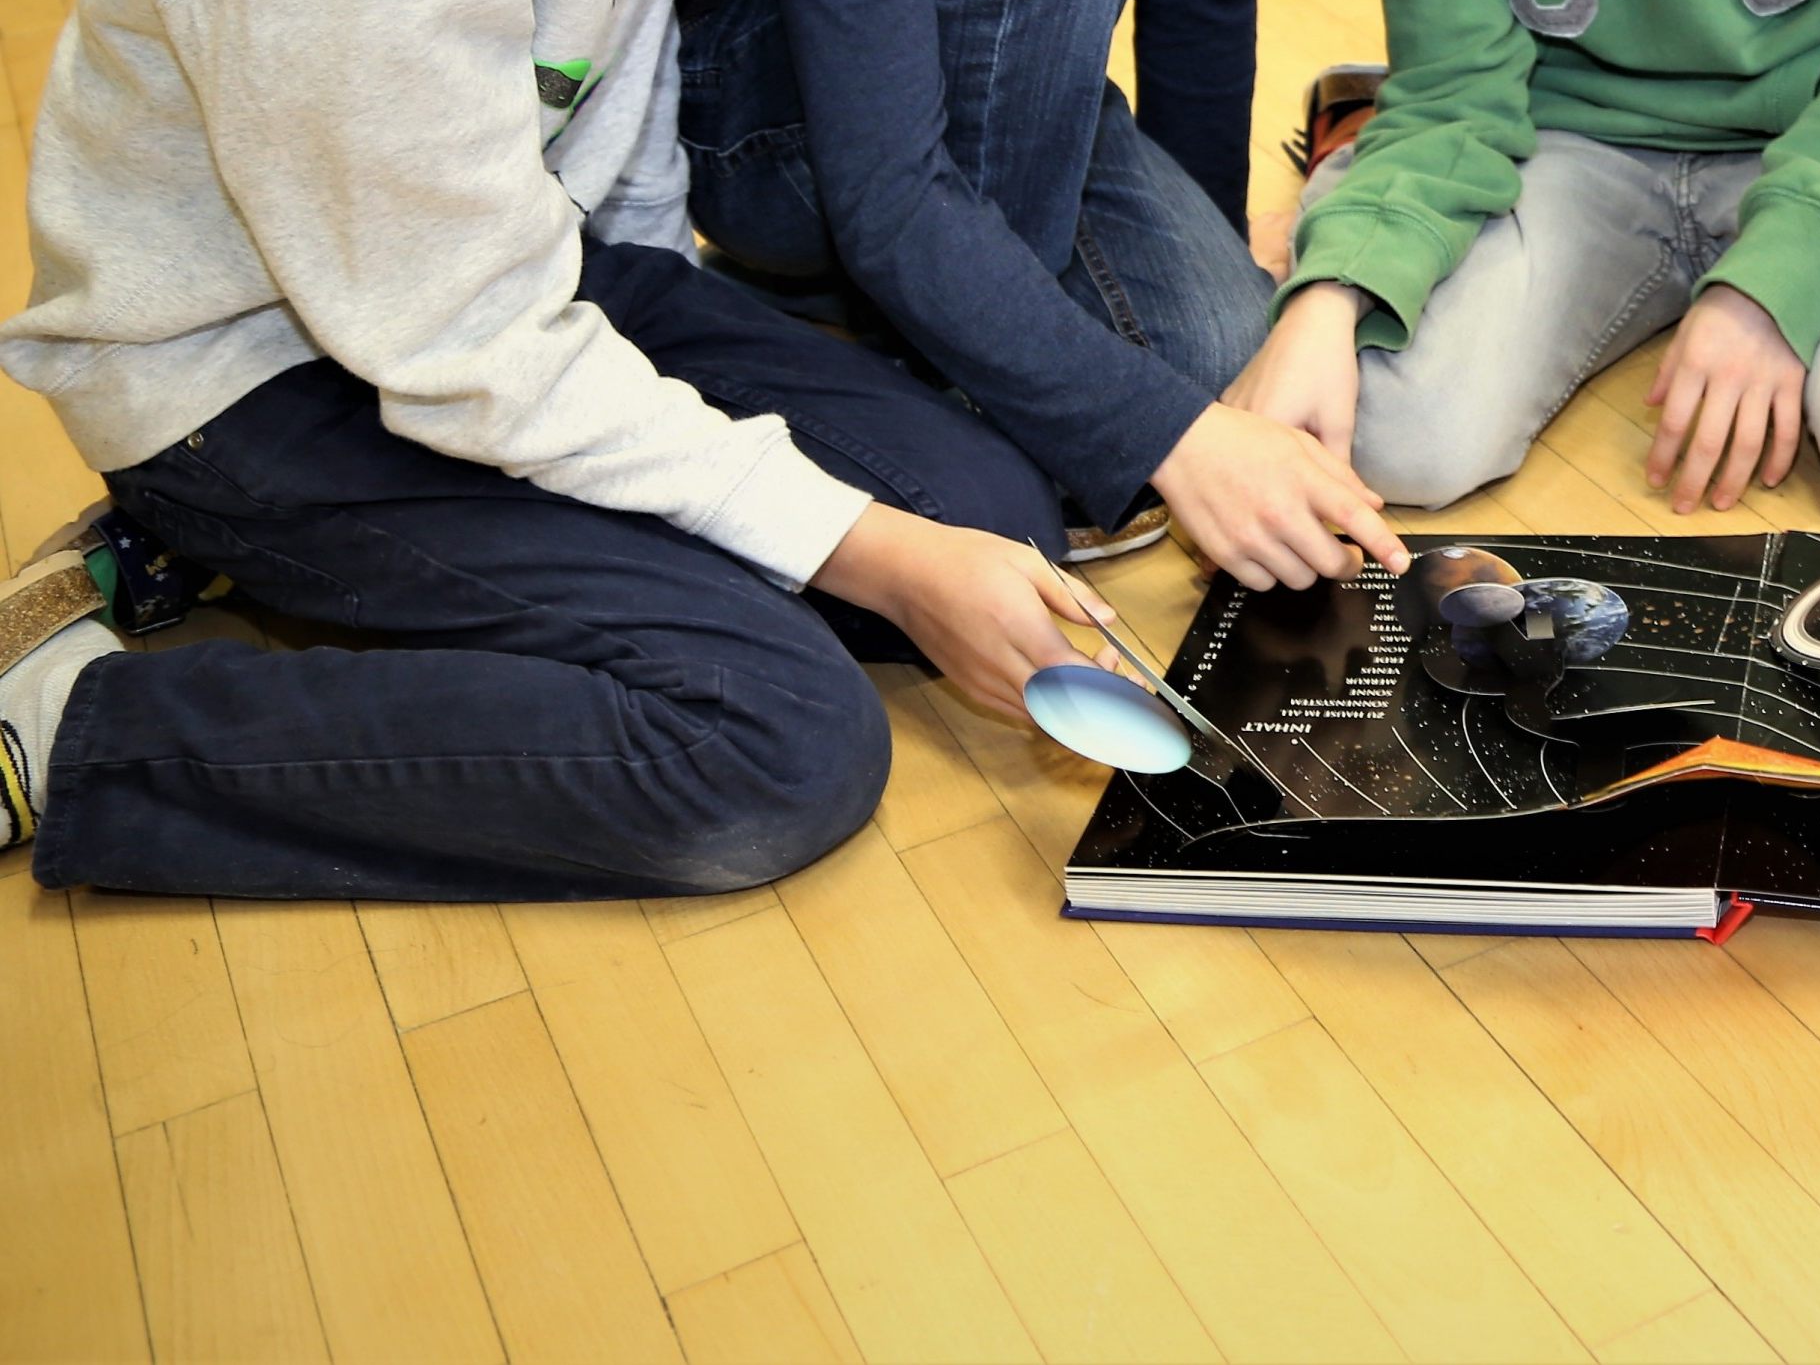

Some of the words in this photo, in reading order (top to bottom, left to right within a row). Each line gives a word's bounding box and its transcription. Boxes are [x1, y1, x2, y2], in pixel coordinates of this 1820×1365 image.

[1379, 635, 1412, 643] MARS
[1367, 645, 1410, 653] MOND
[1372, 656, 1405, 664] ERDE
[1360, 667, 1401, 675] VENUS
[1345, 677, 1398, 686] MERKUR
[1348, 688, 1393, 697] SONNE
[1290, 698, 1389, 708] SONNENSYSTEM
[1304, 710, 1321, 718] IM
[1323, 710, 1364, 719] HAUSE
[1241, 721, 1312, 734] INHALT
